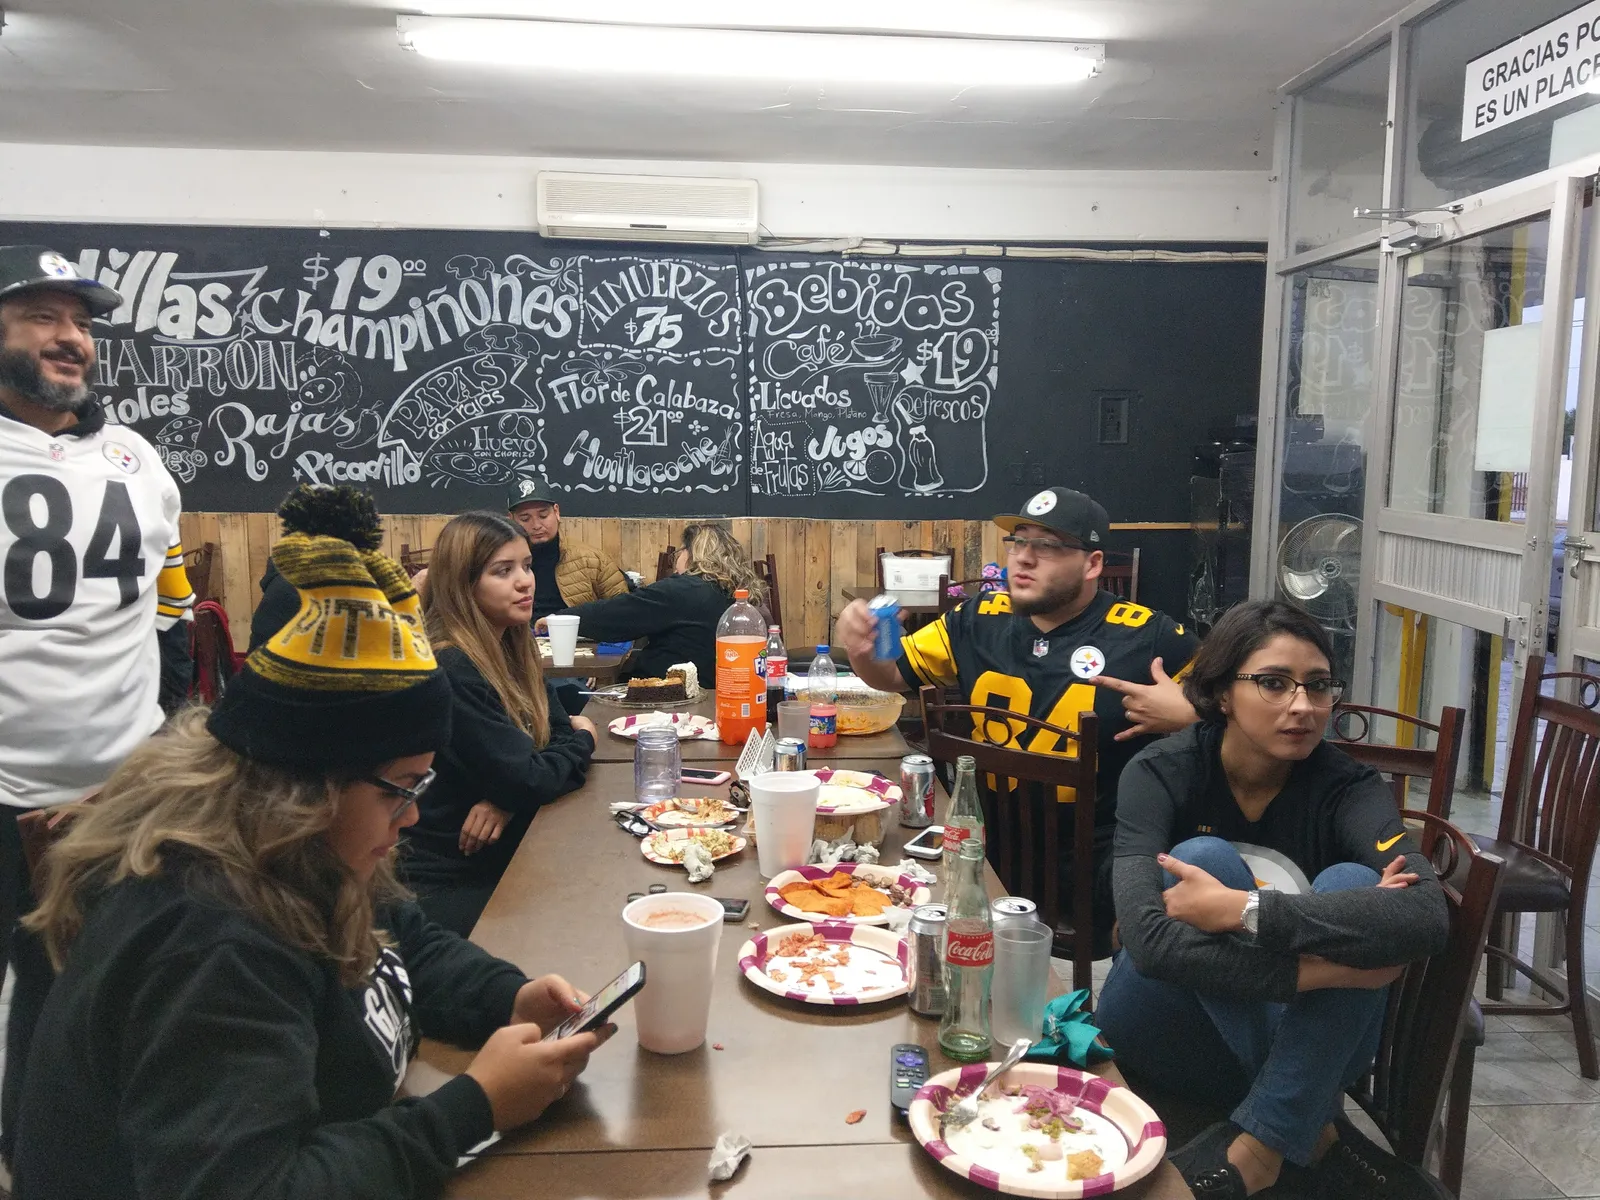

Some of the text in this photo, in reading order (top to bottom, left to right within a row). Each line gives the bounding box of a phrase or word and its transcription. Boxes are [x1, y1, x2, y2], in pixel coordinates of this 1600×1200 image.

[1482, 31, 1569, 92] GRACIAS
[1475, 99, 1497, 128] ES
[1503, 84, 1529, 117] UN
[72, 248, 233, 340] illas
[583, 261, 741, 338] ALMUERZOS
[753, 263, 975, 336] Bebidas
[251, 272, 579, 372] Champiñones
[624, 305, 683, 349] $75
[93, 324, 299, 396] HARRÓN
[763, 323, 853, 380] Café
[916, 327, 990, 389] $19
[389, 354, 508, 439] PAPAS
[547, 373, 735, 420] Flor de Calabaza
[759, 375, 852, 410] Licuados
[895, 390, 984, 425] Refrescos
[208, 402, 356, 482] Rajas
[428, 417, 456, 440] con
[471, 426, 537, 451] Huevo
[612, 405, 668, 446] $21
[752, 420, 794, 465] Agua
[808, 424, 893, 461] Jugos
[155, 444, 208, 484] ueso
[295, 445, 421, 489] Picadillo
[494, 450, 536, 458] CHORIZO
[762, 446, 809, 494] Frutas
[2, 473, 146, 620] 84
[970, 671, 1097, 803] 84
